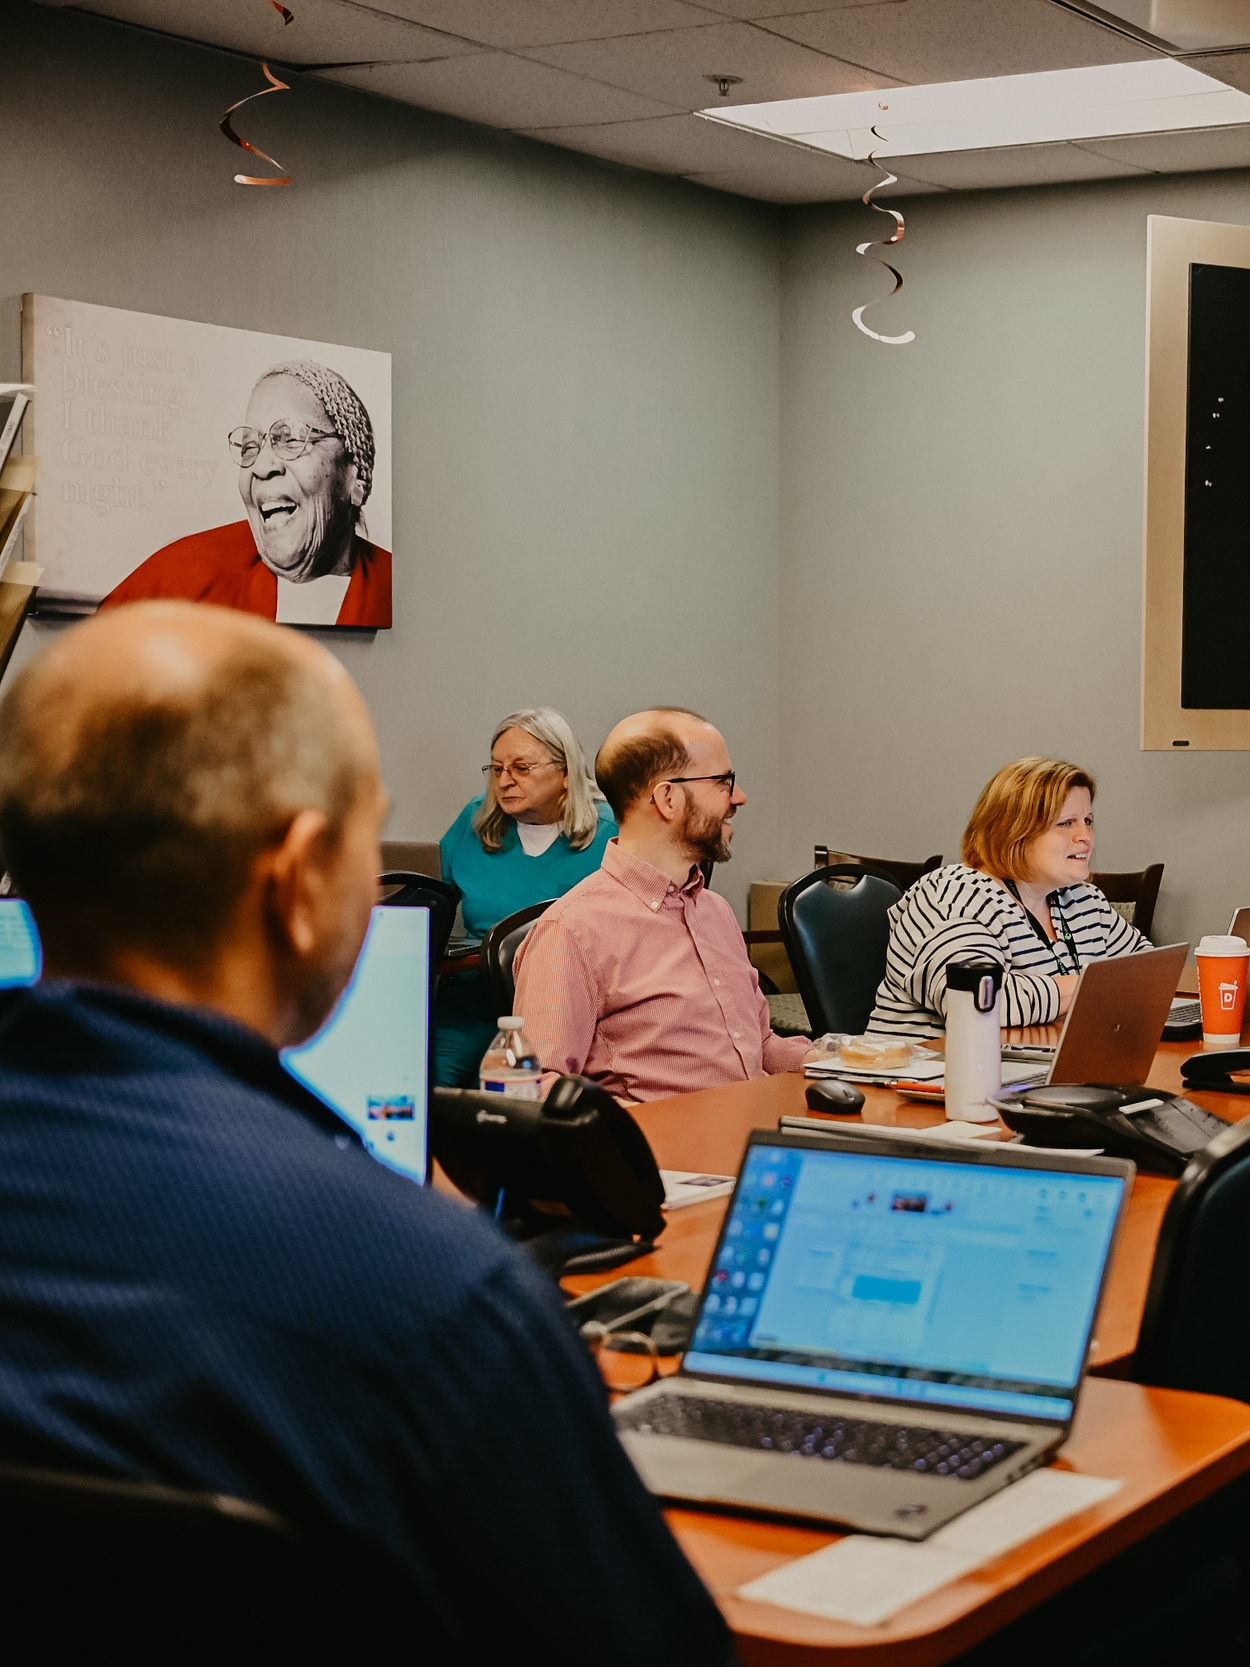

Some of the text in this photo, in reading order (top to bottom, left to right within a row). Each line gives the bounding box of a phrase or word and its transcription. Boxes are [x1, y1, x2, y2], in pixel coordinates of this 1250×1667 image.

[116, 335, 174, 377] just
[185, 356, 200, 377] a
[61, 362, 194, 419] blessing.
[62, 399, 174, 442] I thank
[61, 434, 130, 473] God
[140, 453, 219, 491] every
[62, 472, 168, 517] night.”
[1224, 992, 1233, 1003] D
